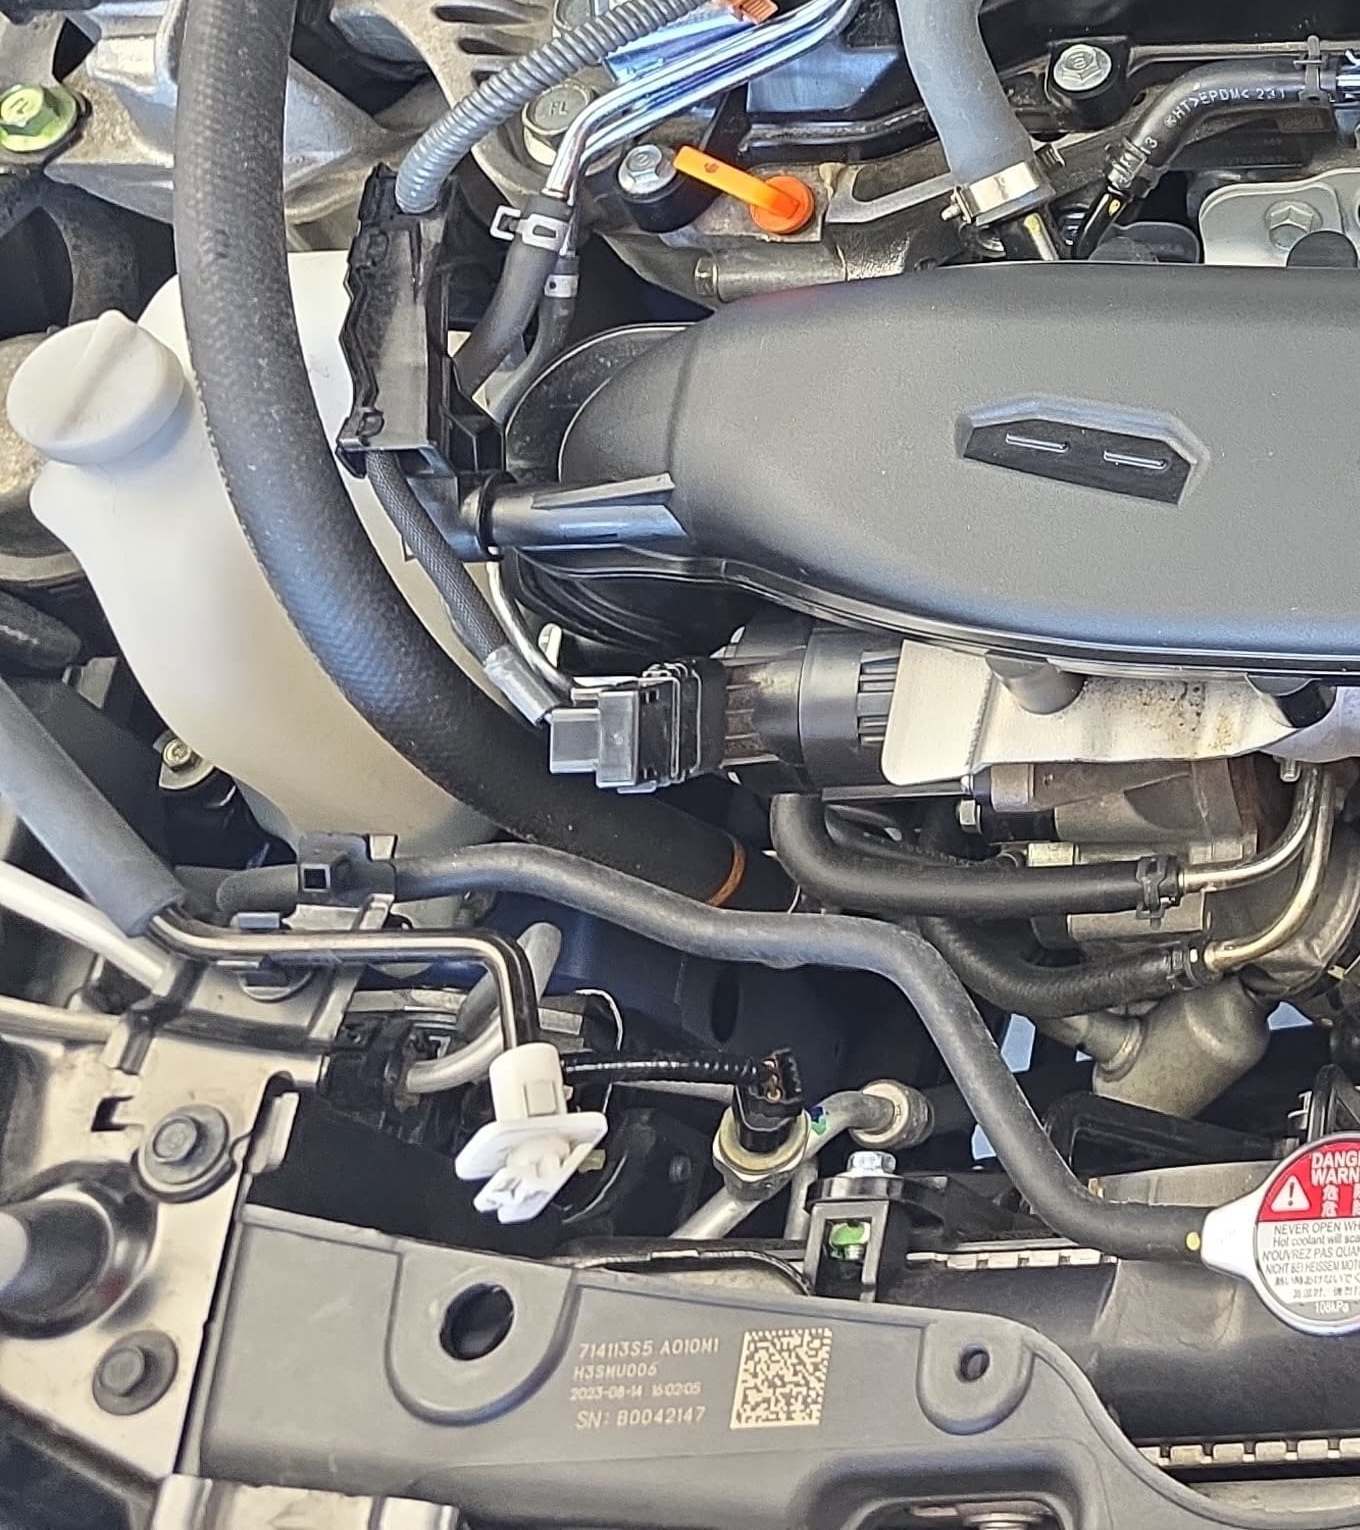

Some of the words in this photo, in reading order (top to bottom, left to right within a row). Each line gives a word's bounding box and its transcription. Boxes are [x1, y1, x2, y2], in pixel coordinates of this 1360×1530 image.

[1274, 1222, 1310, 1235] NEVER
[1311, 1221, 1342, 1234] OPEN
[1272, 1235, 1290, 1248] Hot
[1291, 1234, 1326, 1247] coolant
[1327, 1232, 1342, 1244] will
[1261, 1247, 1312, 1262] N'OUVREZ
[1313, 1247, 1334, 1259] PAS
[1265, 1262, 1290, 1276] NICHT
[1290, 1262, 1304, 1274] BEI
[1315, 1299, 1350, 1314] 108kPa
[579, 1338, 654, 1360] 714113S5
[568, 1385, 644, 1402] 2023-08-14
[616, 1406, 707, 1427] B0042147
